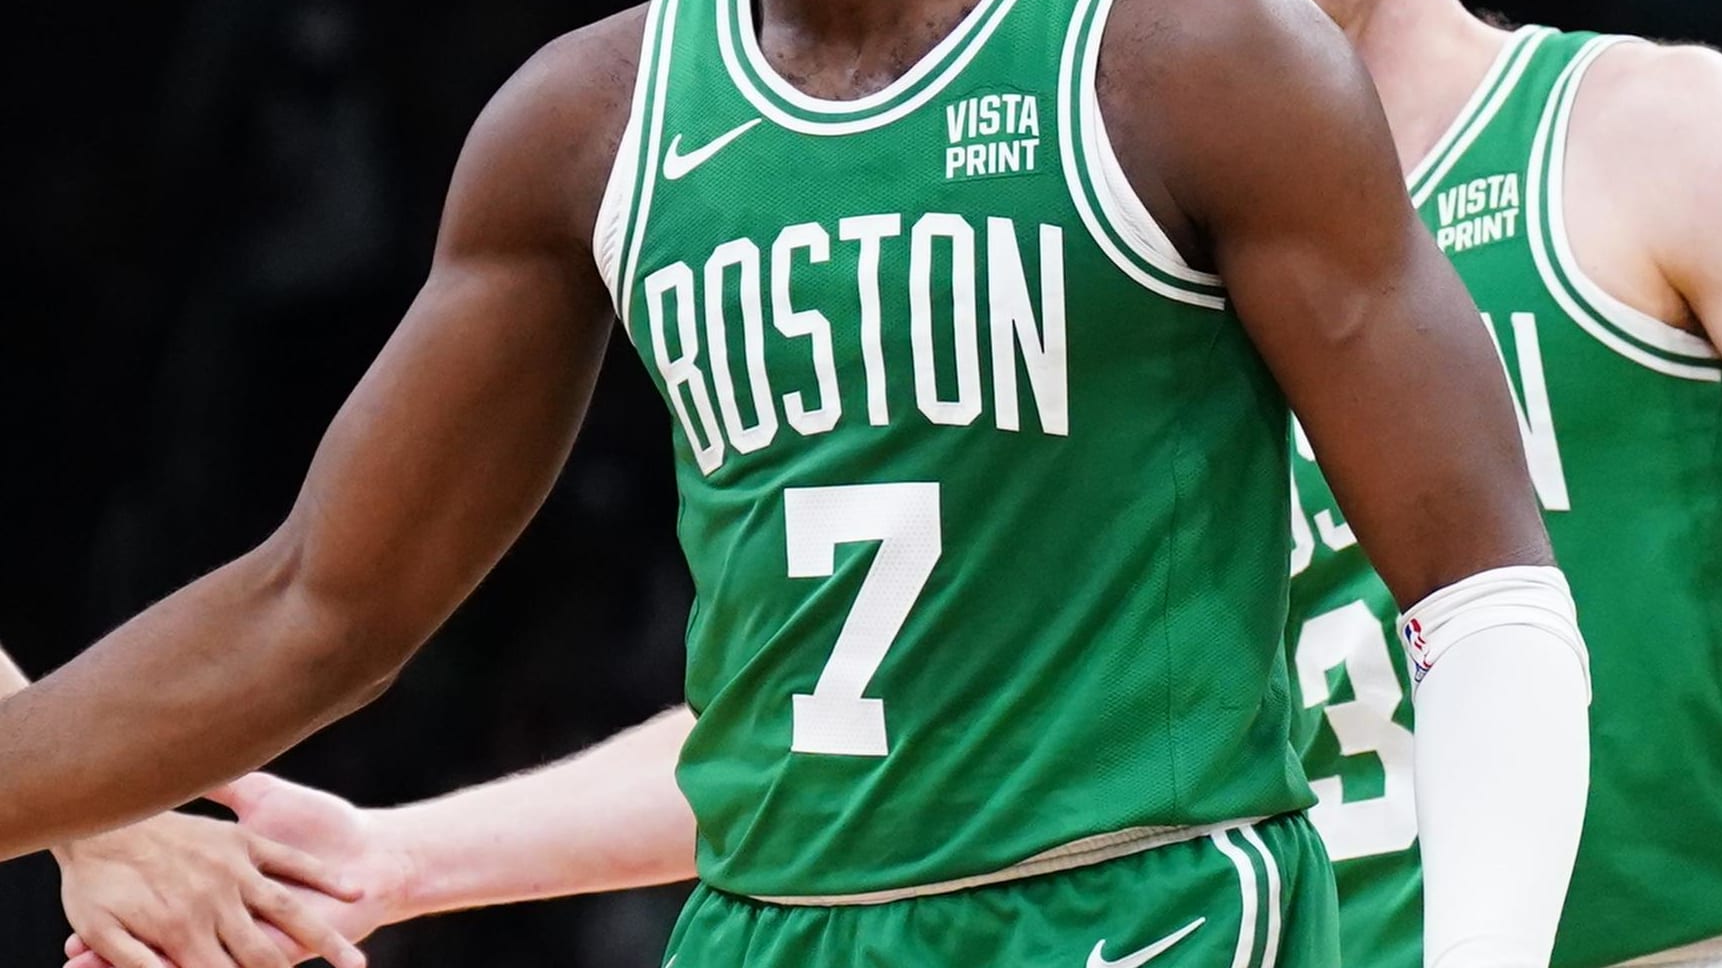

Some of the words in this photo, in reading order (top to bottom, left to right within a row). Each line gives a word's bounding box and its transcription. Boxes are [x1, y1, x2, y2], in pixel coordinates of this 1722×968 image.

[945, 94, 1040, 144] VISTA
[945, 138, 1040, 179] PRINT
[1437, 173, 1519, 227] VISTA
[1437, 208, 1519, 254] PRINT
[644, 212, 1069, 476] BOSTON
[784, 482, 942, 756] 7
